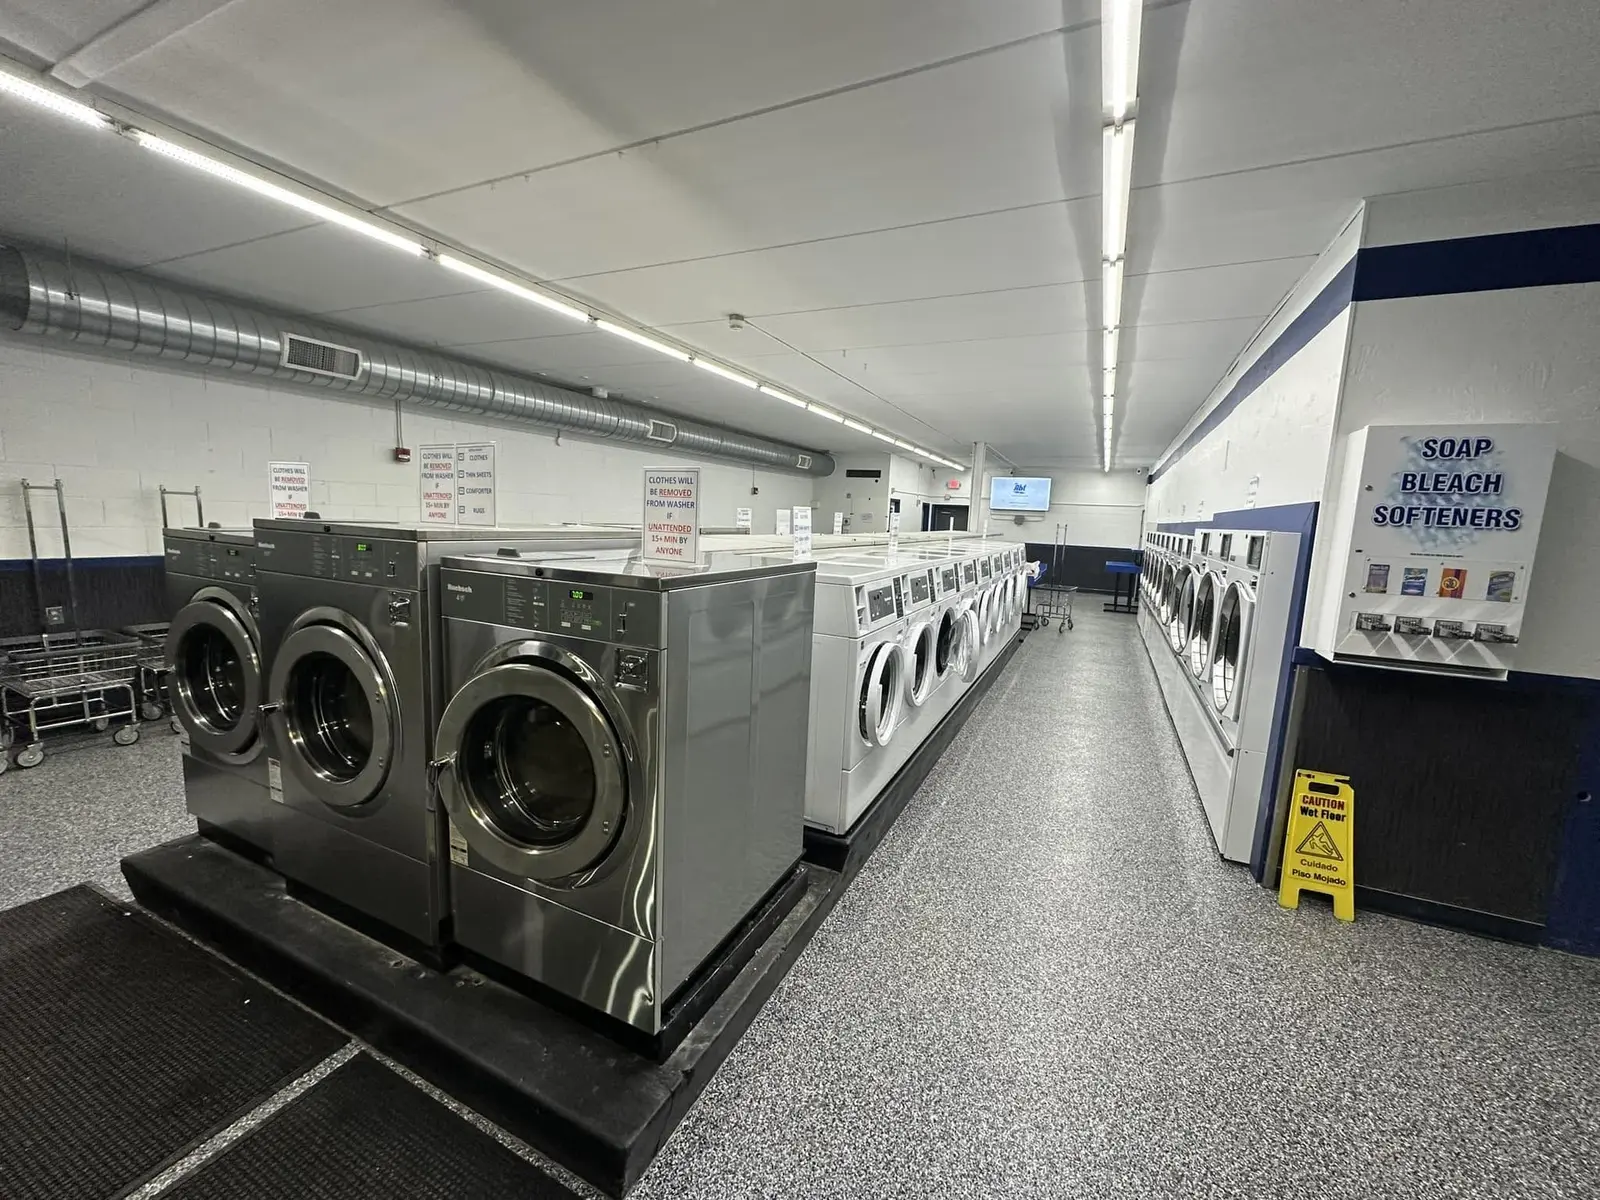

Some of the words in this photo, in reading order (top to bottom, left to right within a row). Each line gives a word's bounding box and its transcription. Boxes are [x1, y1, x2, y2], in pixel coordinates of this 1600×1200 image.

[1422, 438, 1493, 459] SOAP
[1400, 472, 1503, 494] BLEACH
[659, 489, 692, 498] REMOVED
[1372, 505, 1523, 529] SOFTENERS
[648, 523, 691, 534] UNATTENDED
[656, 547, 682, 555] ANYONE
[1302, 795, 1344, 810] CAUTION
[1300, 806, 1318, 818] Wet
[1321, 810, 1346, 822] Floor
[1301, 858, 1338, 872] Cuidado
[1292, 869, 1311, 879] Piso
[1314, 874, 1346, 886] Mojado
